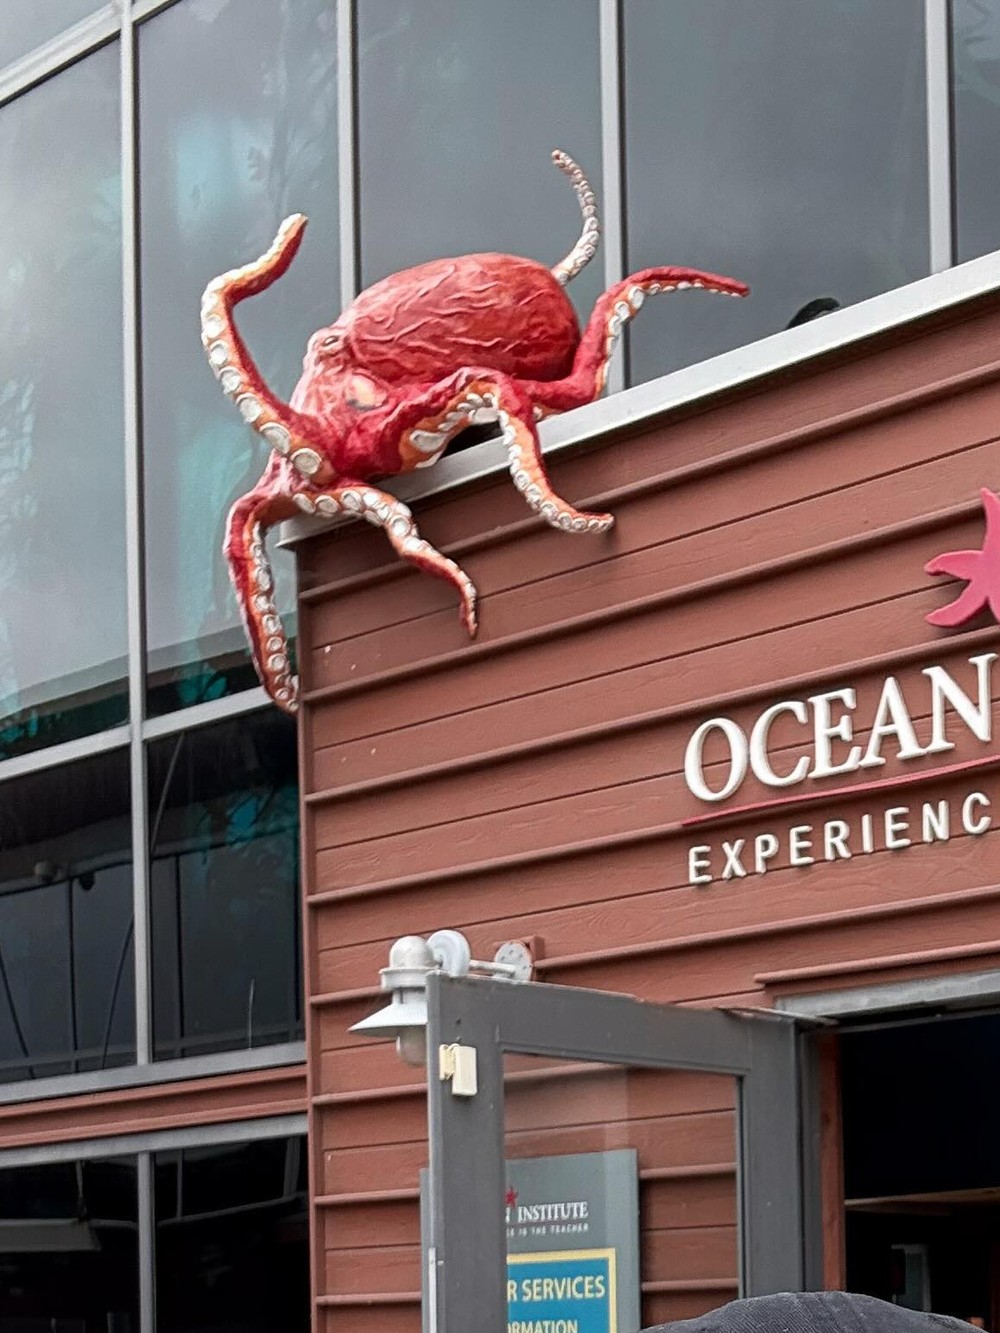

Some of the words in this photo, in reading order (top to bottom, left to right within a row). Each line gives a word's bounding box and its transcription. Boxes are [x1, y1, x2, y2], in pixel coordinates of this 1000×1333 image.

[683, 653, 996, 802] OCEAN
[518, 1202, 588, 1223] INSTITUTE
[522, 1275, 605, 1302] SERVICES
